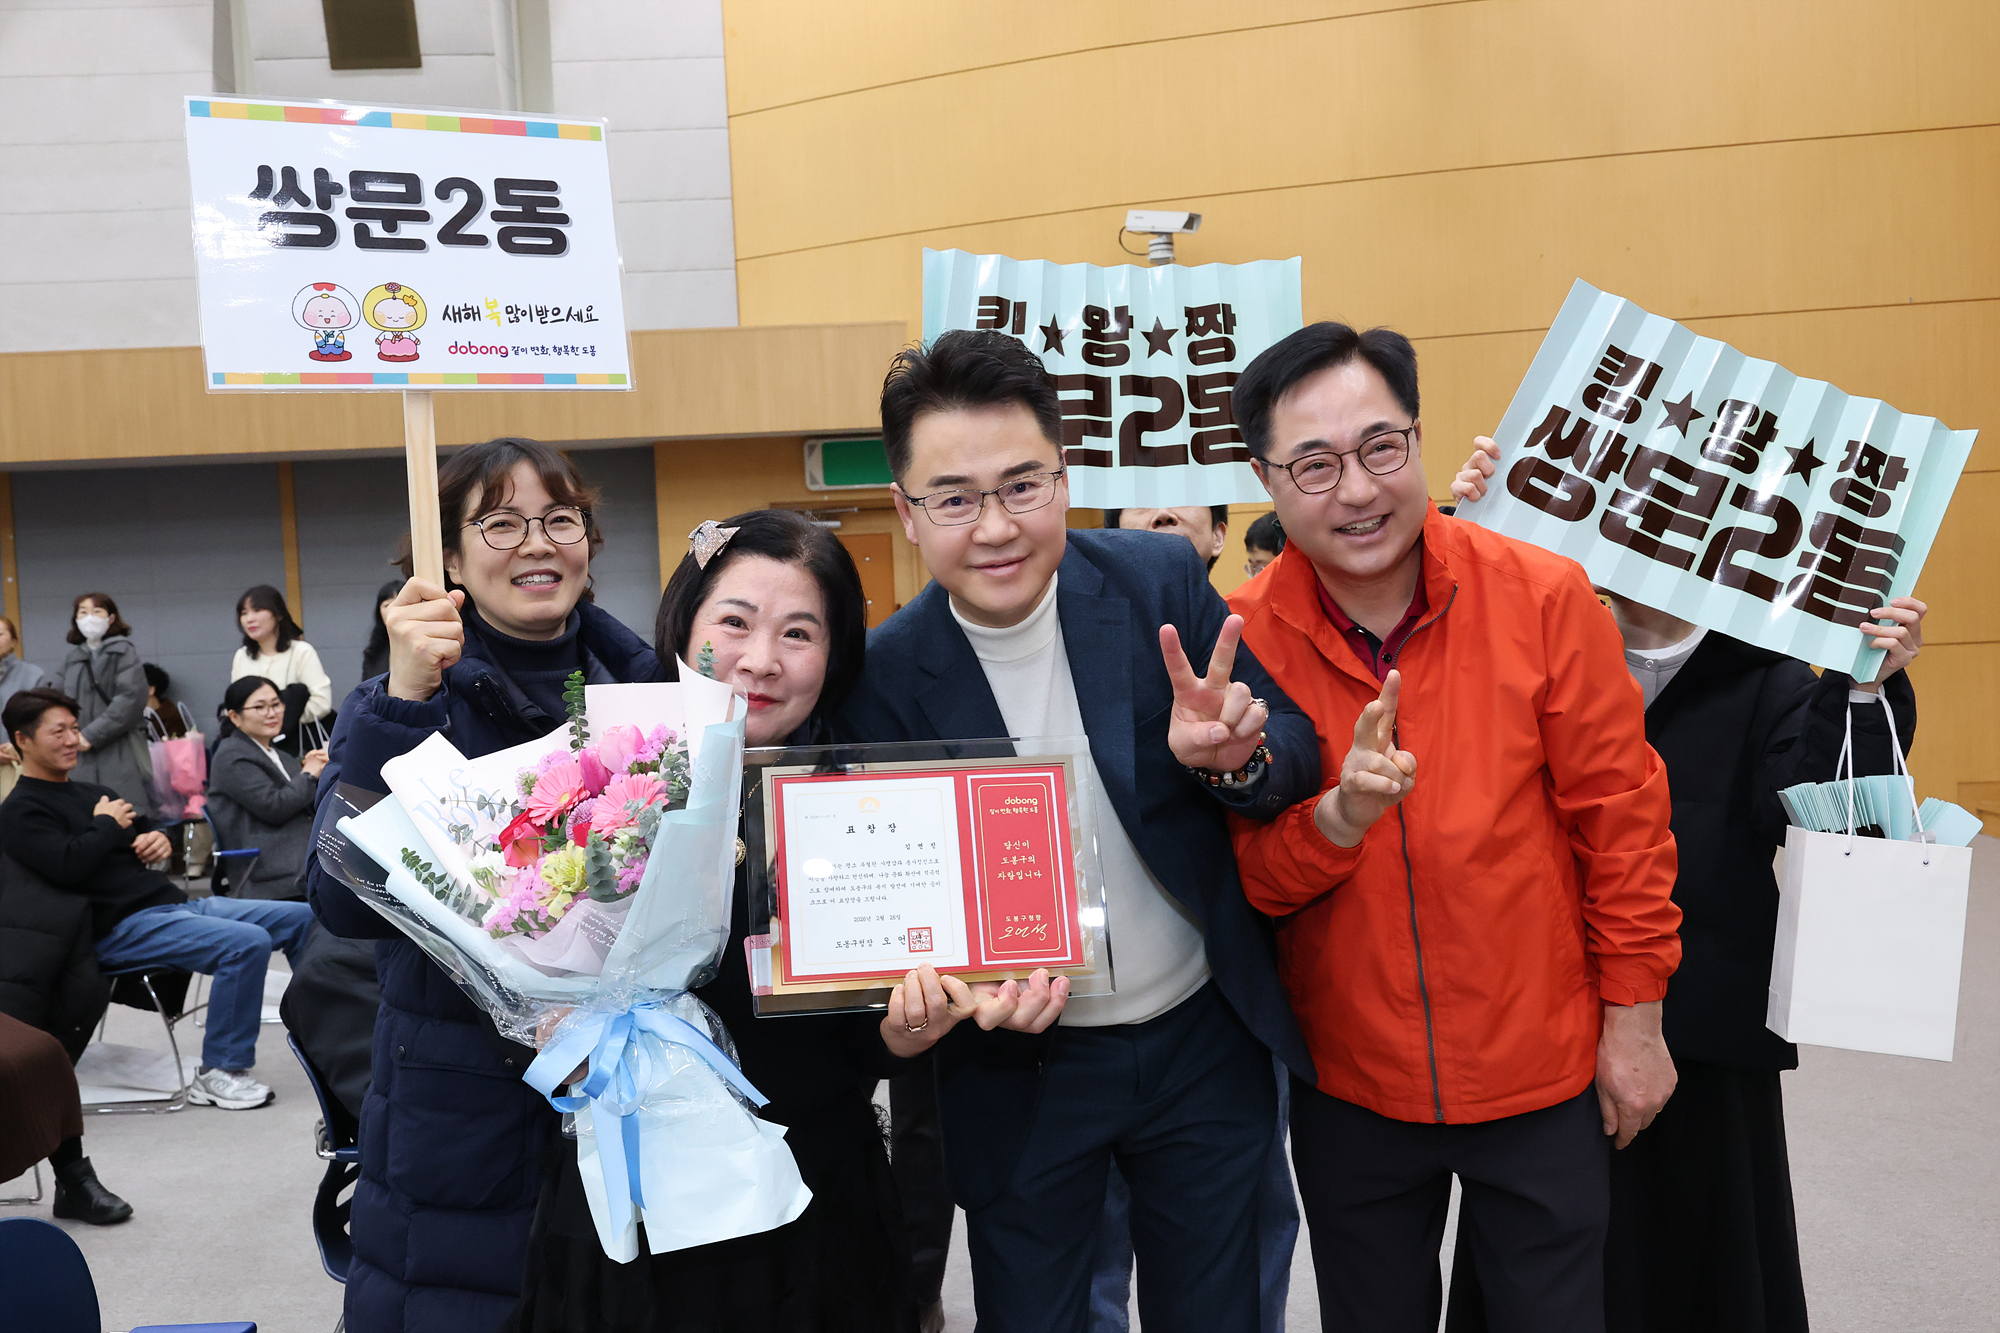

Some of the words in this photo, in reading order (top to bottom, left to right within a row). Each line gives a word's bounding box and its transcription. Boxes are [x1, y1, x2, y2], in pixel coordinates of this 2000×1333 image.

[248, 164, 572, 256] 쌍문2동
[442, 303, 481, 323] 새해
[485, 297, 501, 327] 복
[1081, 304, 1133, 367] 왕
[1184, 302, 1237, 366] 짱
[448, 341, 508, 358] dobong
[511, 346, 528, 355] 같이
[552, 345, 579, 356] 행복한
[582, 345, 596, 357] 도봉
[1048, 372, 1251, 467] 문2동
[1582, 344, 1664, 424] 킹
[1700, 398, 1779, 474] 왕
[1829, 439, 1909, 519] 짱
[1506, 404, 1907, 629] 쌍문2동
[1004, 796, 1038, 806] dobong
[1003, 840, 1030, 850] 당신이
[1001, 854, 1036, 865] 도봉구의
[997, 870, 1042, 880] 자랑입니다
[1005, 914, 1041, 922] 도봉구청장
[835, 939, 873, 949] 도봉구청장
